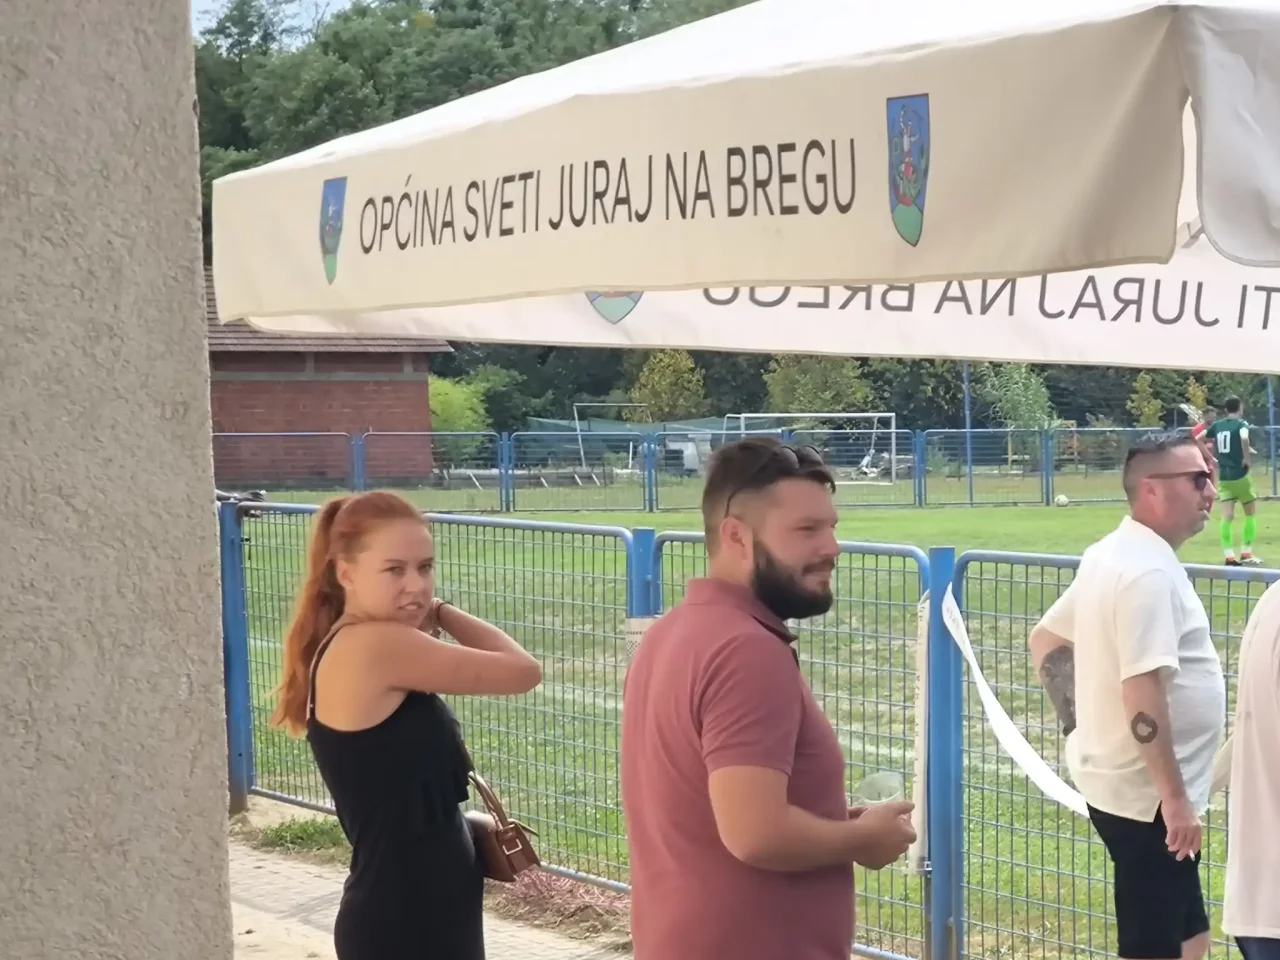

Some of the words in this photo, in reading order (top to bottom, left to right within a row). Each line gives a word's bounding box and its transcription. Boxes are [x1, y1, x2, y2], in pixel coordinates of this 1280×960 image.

[359, 173, 456, 255] OPĆINA
[463, 169, 541, 242] SVETI
[548, 154, 653, 230] JURAJ
[664, 150, 716, 221] NA
[726, 138, 856, 217] BREGU
[1216, 431, 1231, 453] 10
